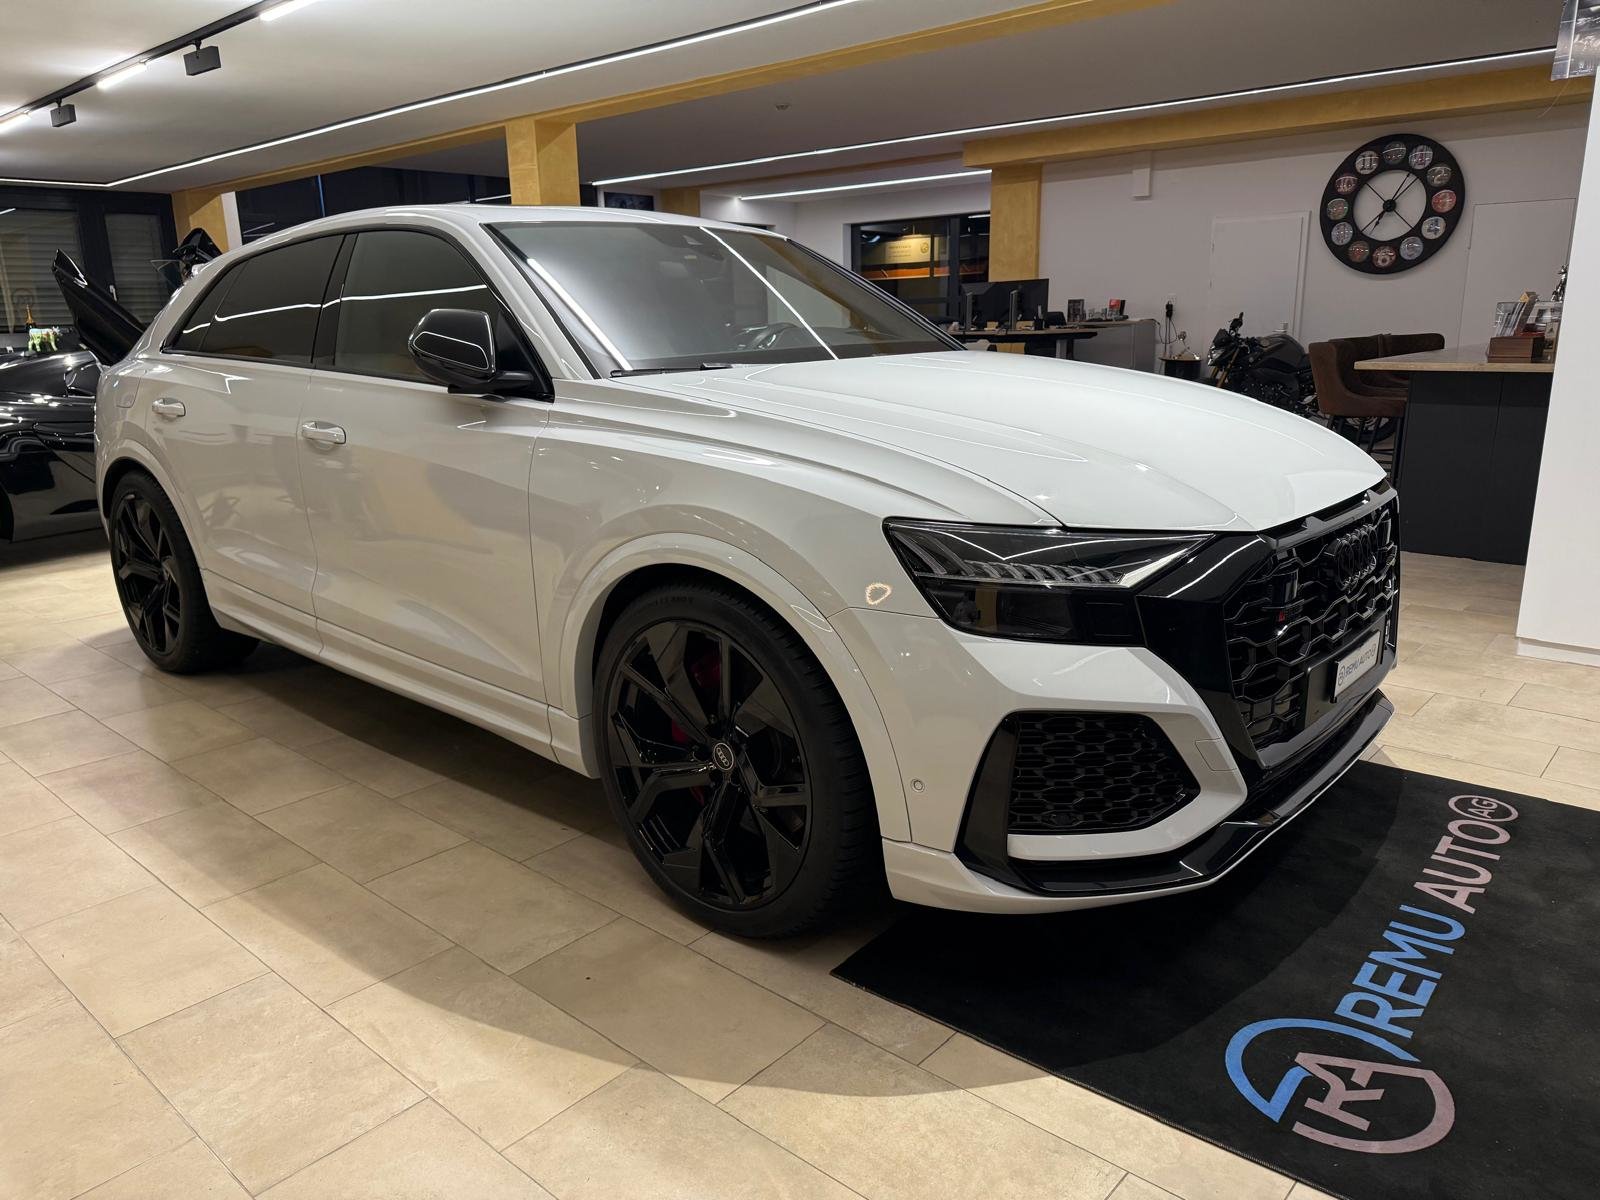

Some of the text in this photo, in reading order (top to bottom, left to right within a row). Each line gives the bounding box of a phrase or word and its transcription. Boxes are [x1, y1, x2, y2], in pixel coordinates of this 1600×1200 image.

[1334, 797, 1511, 1040] REMU AUTO AG
